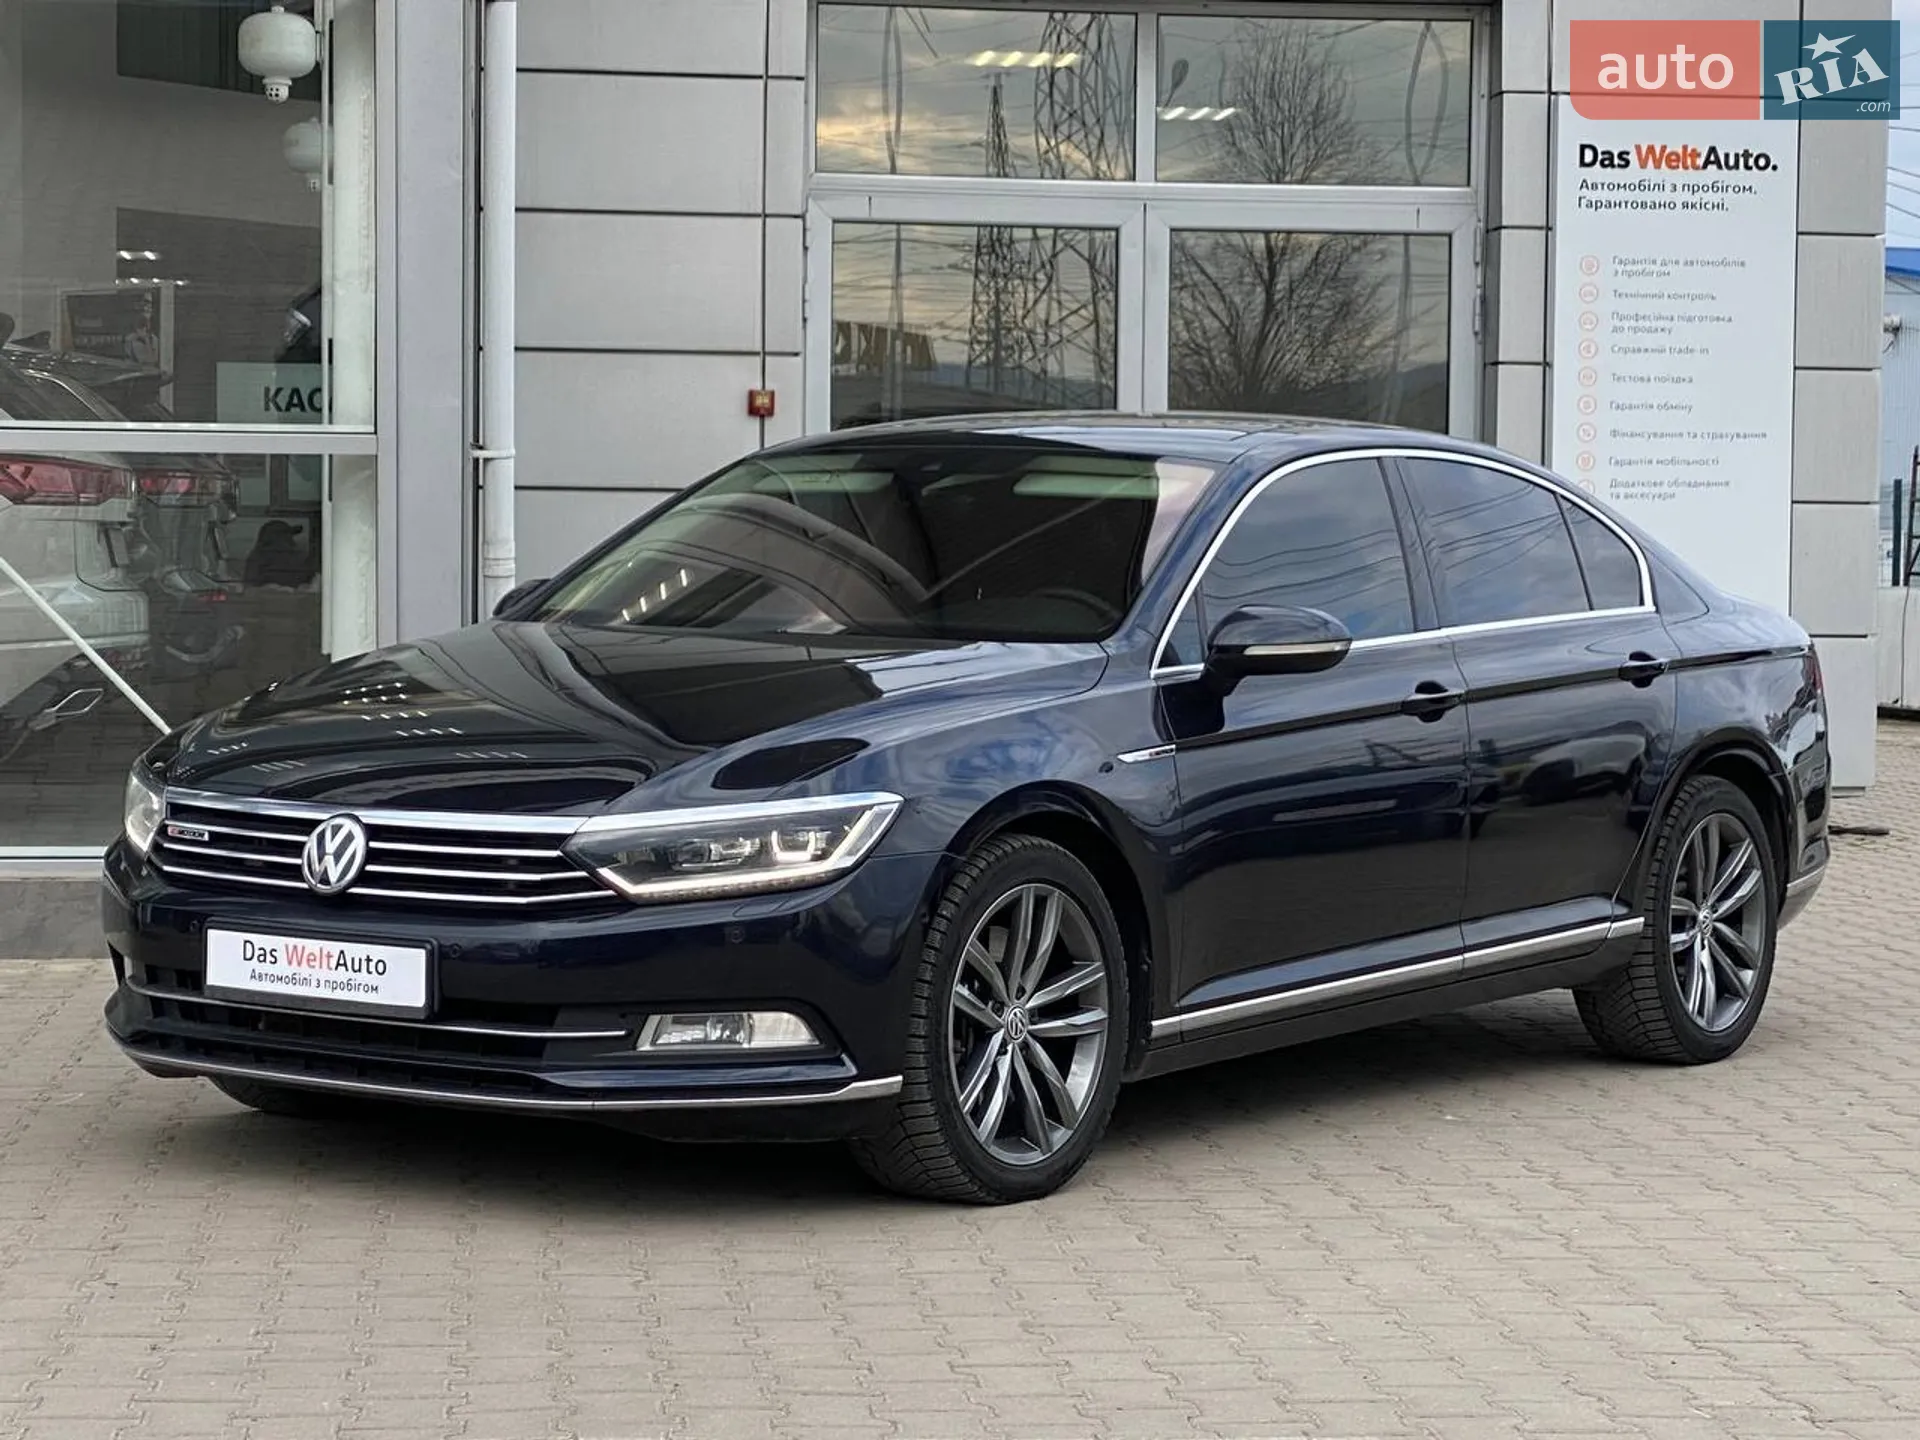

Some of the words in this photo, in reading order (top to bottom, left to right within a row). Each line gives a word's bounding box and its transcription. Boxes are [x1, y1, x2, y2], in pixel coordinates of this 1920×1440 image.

[1578, 143, 1630, 170] Das
[1634, 144, 1779, 172] WeltAuto.
[1579, 179, 1665, 194] Автомобілі
[1669, 181, 1678, 193] з
[1681, 179, 1757, 196] пробігом.
[1578, 195, 1676, 211] Гарантовано
[1681, 197, 1729, 212] якісні.
[1612, 255, 1657, 266] Гарантія
[1660, 257, 1680, 267] для
[1611, 325, 1625, 334] до
[1627, 326, 1673, 335] продажу
[1612, 372, 1652, 384] Тестова
[263, 386, 333, 413] КАС
[1609, 400, 1654, 412] Гарантія
[1686, 431, 1698, 440] та
[1608, 456, 1653, 468] Гарантія
[242, 939, 278, 965] Das
[284, 943, 387, 976] WeltAuto
[250, 968, 312, 988] Автомобілі
[315, 979, 321, 988] з
[323, 977, 379, 994] пробігом
